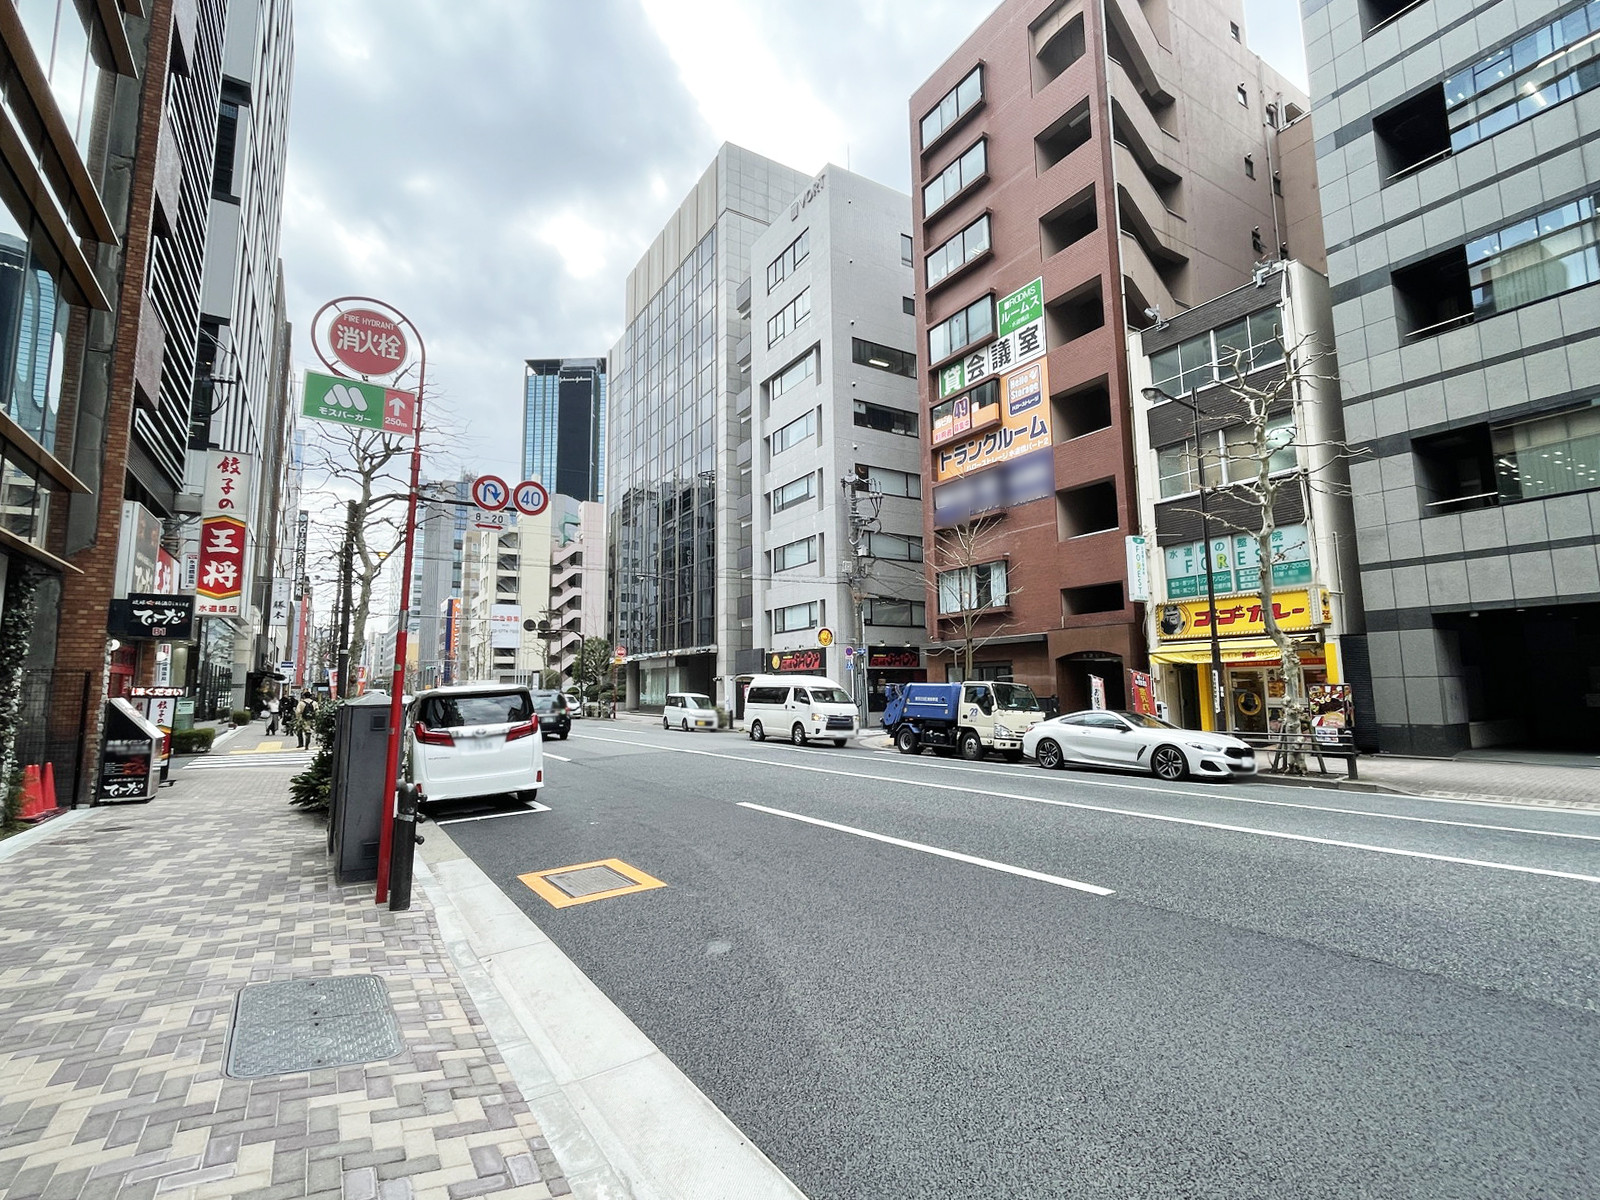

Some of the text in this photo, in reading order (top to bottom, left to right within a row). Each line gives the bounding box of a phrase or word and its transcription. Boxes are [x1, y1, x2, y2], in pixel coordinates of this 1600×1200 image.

[1008, 285, 1036, 307] ROOMS
[1000, 294, 1040, 325] ルームス
[343, 313, 395, 331] FIRE HYDRANT
[336, 324, 402, 360] 消火栓
[1009, 375, 1029, 390] Hello
[1010, 381, 1039, 400] Storage
[318, 406, 372, 422] モスバーガー
[384, 416, 408, 428] 250m
[939, 415, 1048, 473] トランクルーム
[216, 455, 241, 510] 餃子の
[521, 489, 541, 506] 40
[202, 527, 240, 589] 王将
[198, 604, 238, 613] 水道橋店
[152, 627, 167, 637] B1
